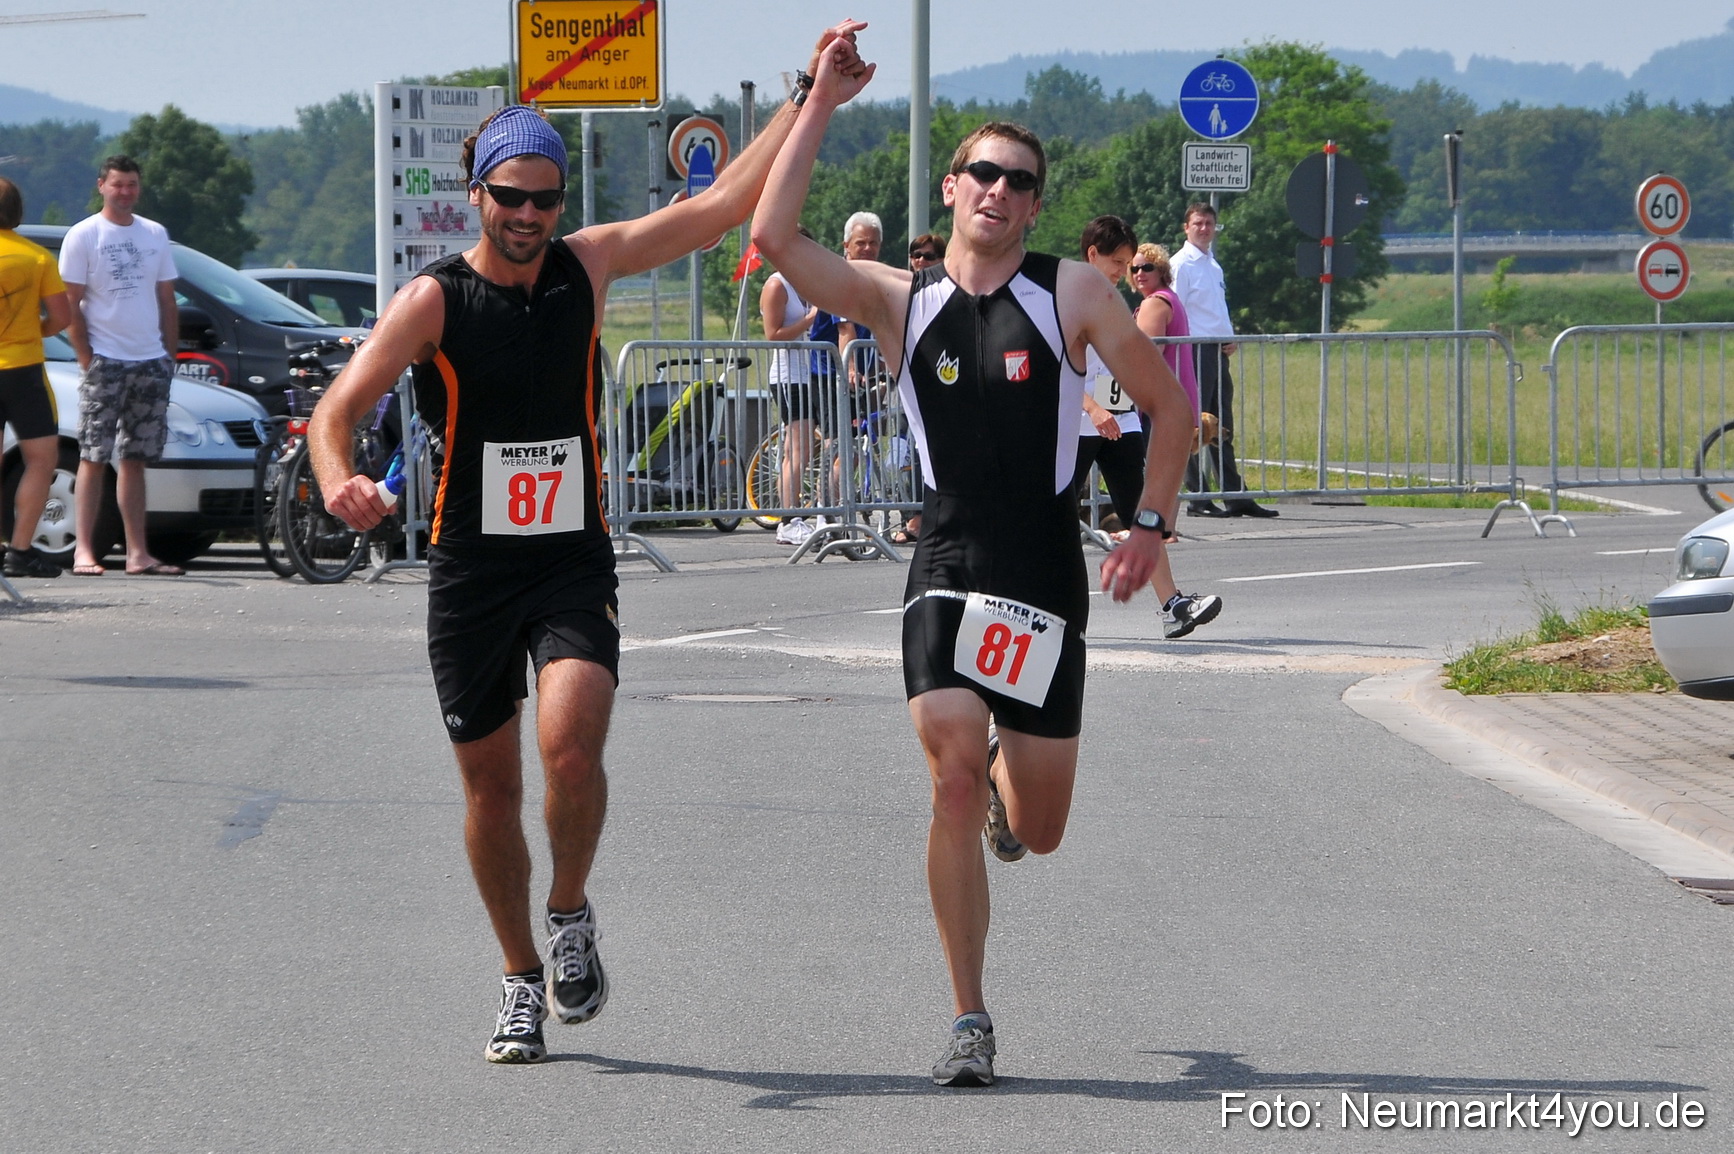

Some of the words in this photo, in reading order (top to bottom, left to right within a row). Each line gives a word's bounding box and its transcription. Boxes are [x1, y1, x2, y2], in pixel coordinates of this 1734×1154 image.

[530, 11, 646, 45] Sengenthal
[545, 49, 571, 62] am
[579, 46, 630, 65] Anger
[528, 76, 553, 90] Kreis
[559, 76, 609, 90] Neumarkt
[614, 75, 650, 90] i.d.OPf.
[430, 89, 479, 107] HOLZAMMER
[1195, 149, 1239, 160] Landwirt-
[1190, 161, 1244, 173] schaftlicher
[405, 167, 430, 195] SHB
[1190, 174, 1225, 185] Verkehr
[1227, 174, 1244, 185] frei
[1650, 192, 1679, 220] 60
[174, 363, 210, 375] ART
[1109, 379, 1122, 406] 9
[500, 445, 549, 459] MEYER
[500, 457, 549, 467] WERBUNG
[508, 470, 563, 527] 87
[983, 605, 1029, 628] WERBUNG
[984, 598, 1031, 619] MEYER
[975, 622, 1034, 686] 81
